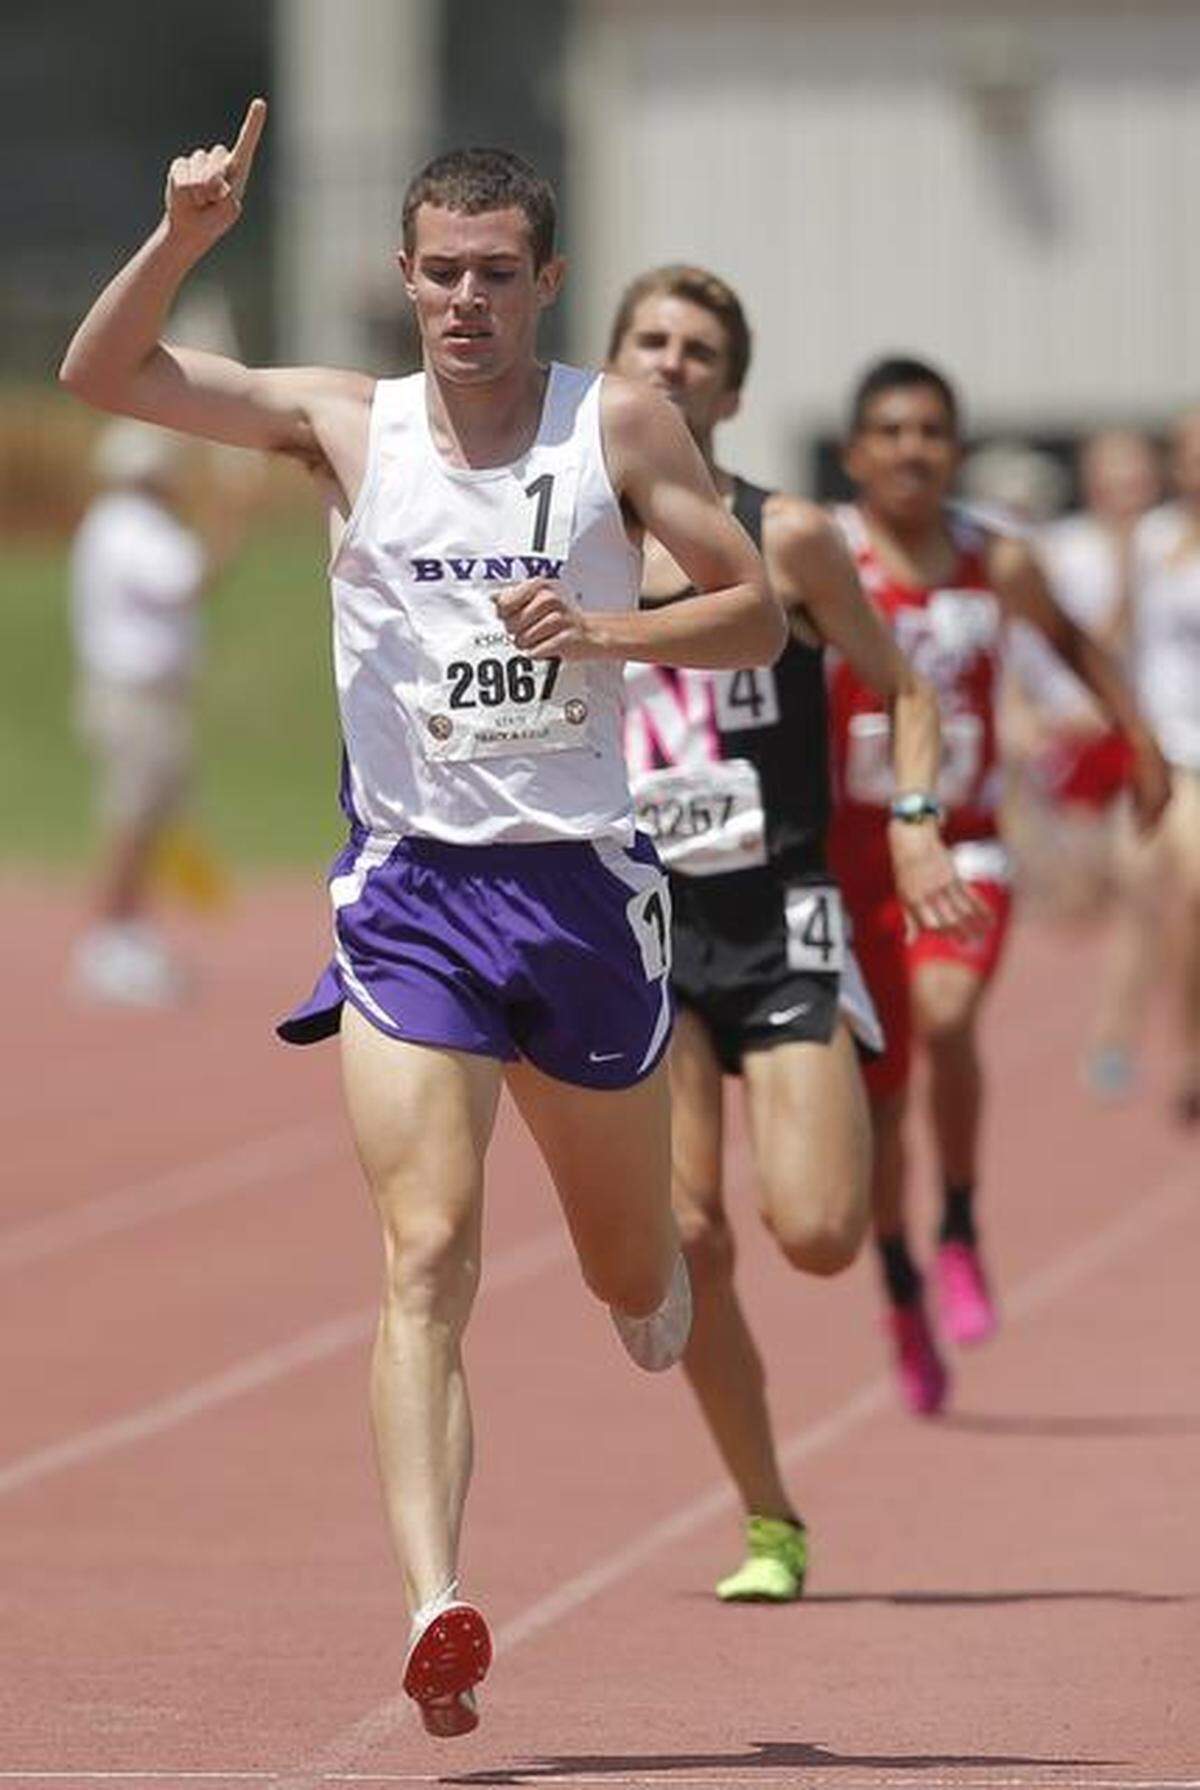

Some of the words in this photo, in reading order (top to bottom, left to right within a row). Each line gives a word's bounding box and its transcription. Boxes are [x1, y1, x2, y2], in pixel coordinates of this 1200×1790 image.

[525, 474, 555, 553] 1
[410, 556, 565, 583] BVNW
[446, 655, 562, 709] 2967
[729, 669, 765, 718] 4
[802, 896, 834, 963] 4
